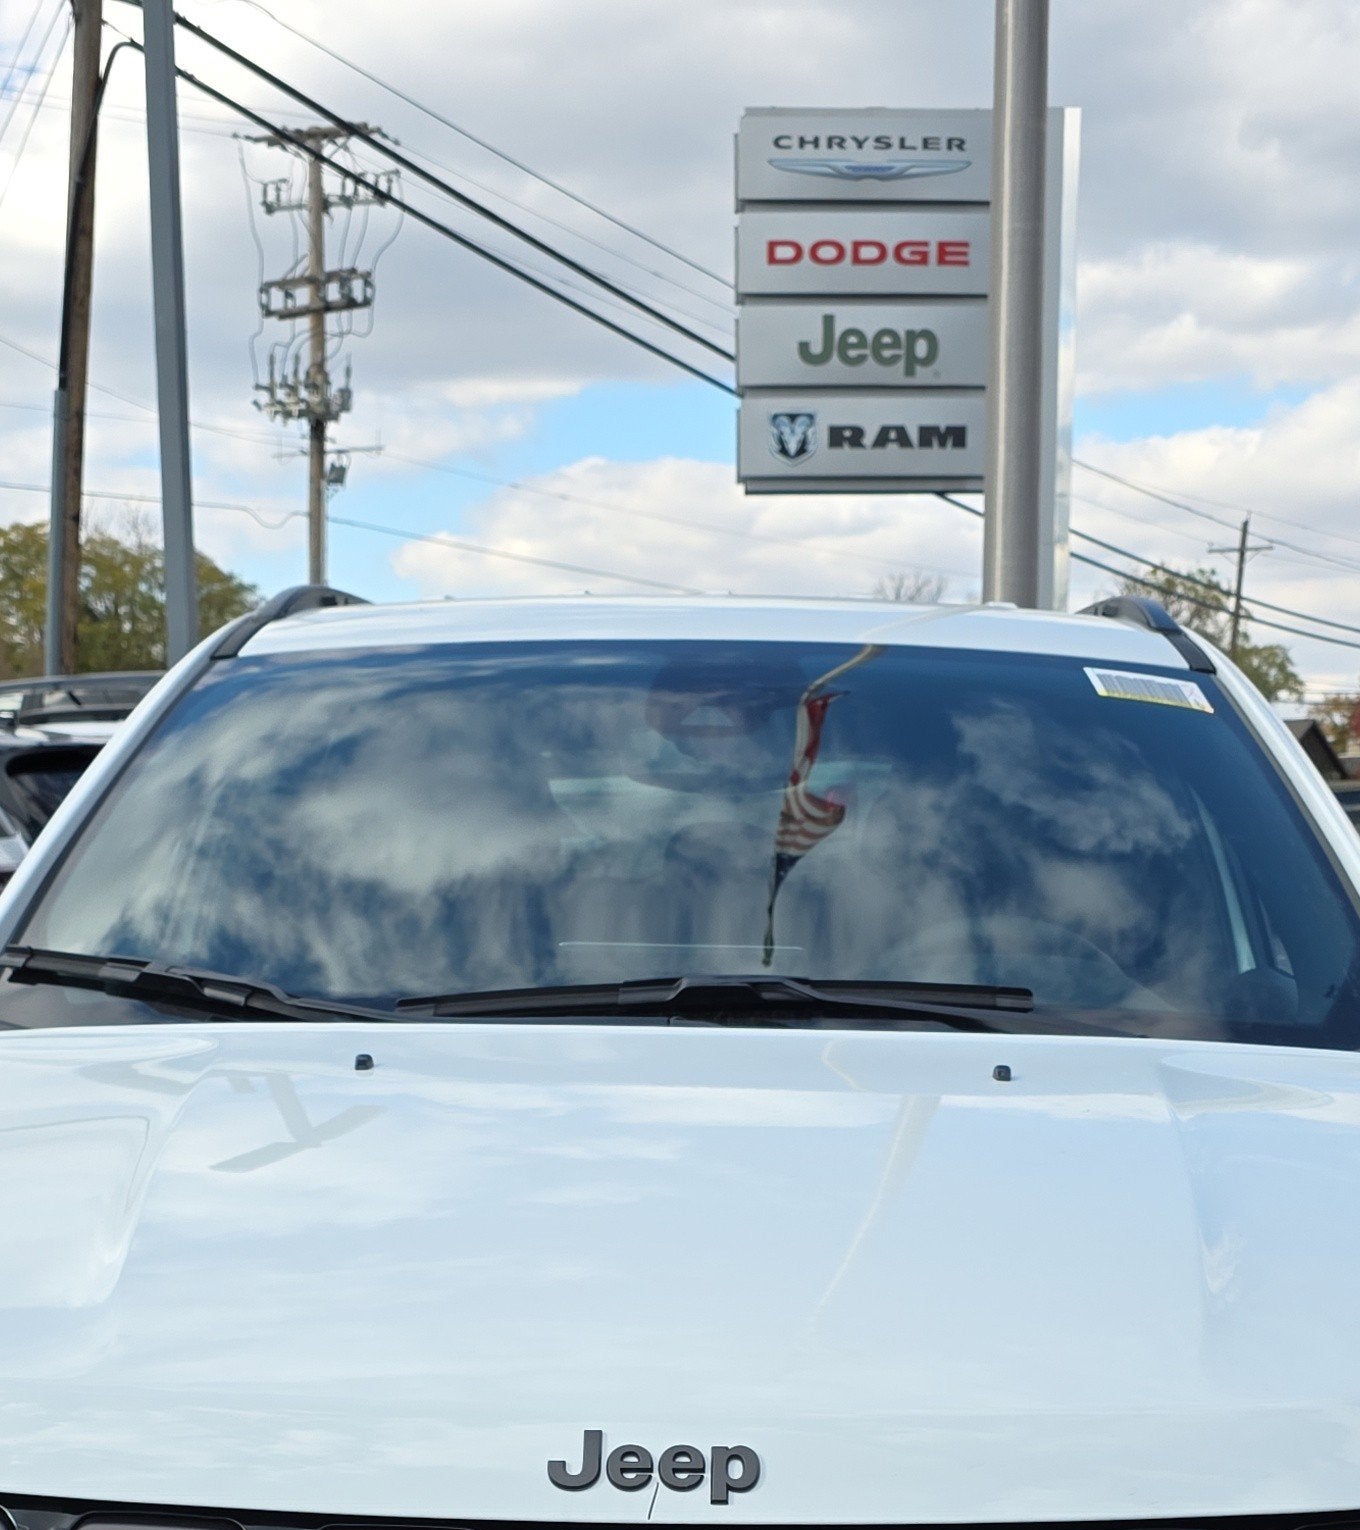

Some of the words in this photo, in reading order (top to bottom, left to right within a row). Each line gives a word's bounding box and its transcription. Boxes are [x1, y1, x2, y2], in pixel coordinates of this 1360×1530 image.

[773, 135, 968, 152] CHRYSLER
[766, 240, 970, 266] DODGE
[797, 314, 939, 377] Jeep
[827, 425, 967, 449] RAM
[547, 1429, 761, 1506] Jeep
